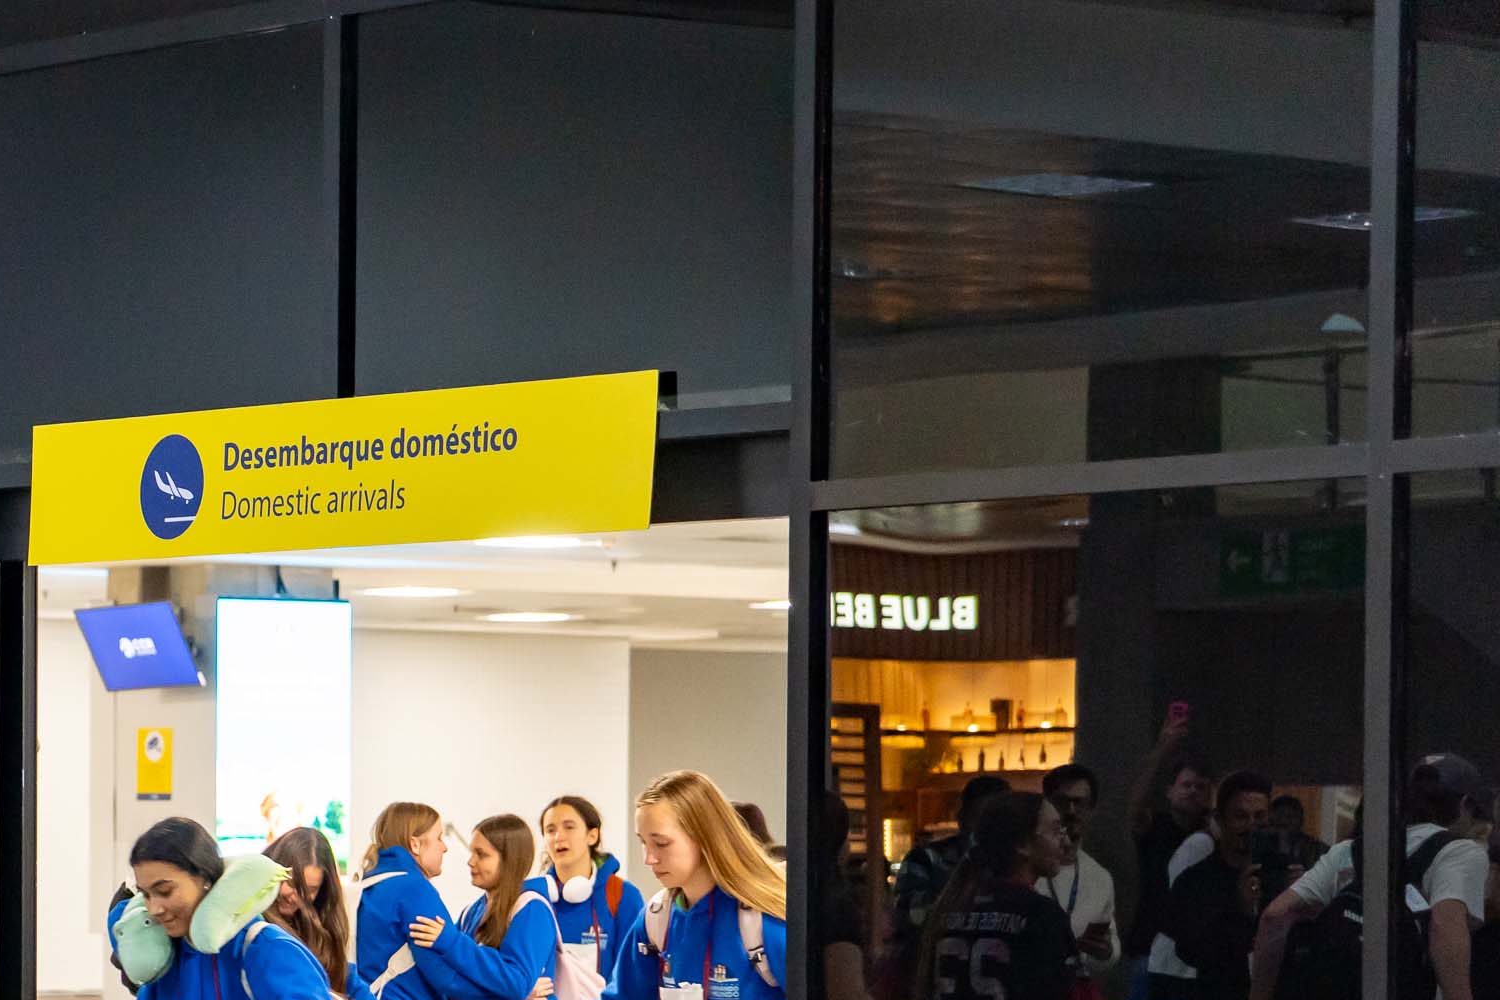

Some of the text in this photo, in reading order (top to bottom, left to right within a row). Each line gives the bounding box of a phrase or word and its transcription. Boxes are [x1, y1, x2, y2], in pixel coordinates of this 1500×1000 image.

[224, 421, 518, 471] Desembarque doméstico
[222, 479, 405, 520] Domestic arrivals
